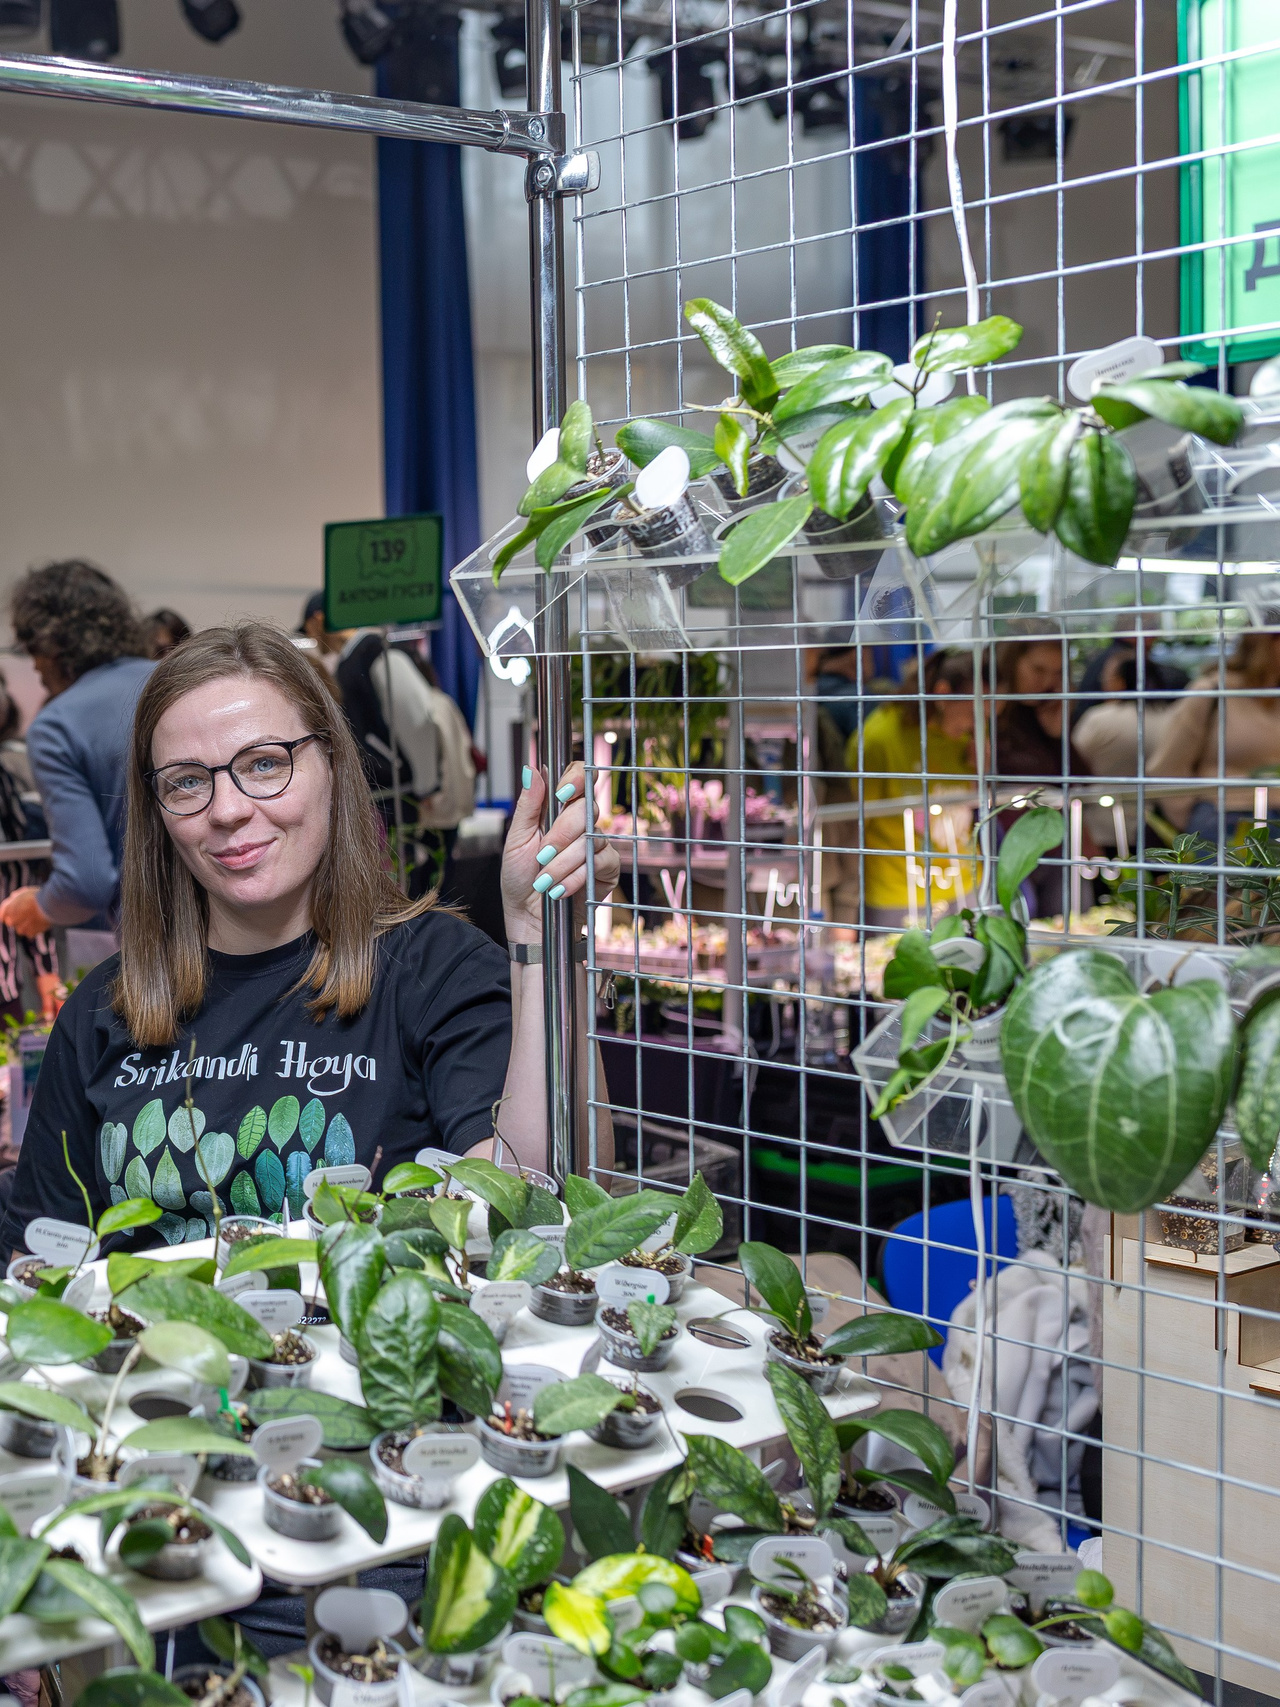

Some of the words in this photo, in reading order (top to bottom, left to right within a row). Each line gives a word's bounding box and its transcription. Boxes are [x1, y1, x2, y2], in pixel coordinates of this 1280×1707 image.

[370, 539, 407, 564] 139
[114, 1043, 259, 1090] Srikandi
[275, 1040, 377, 1096] Hoya
